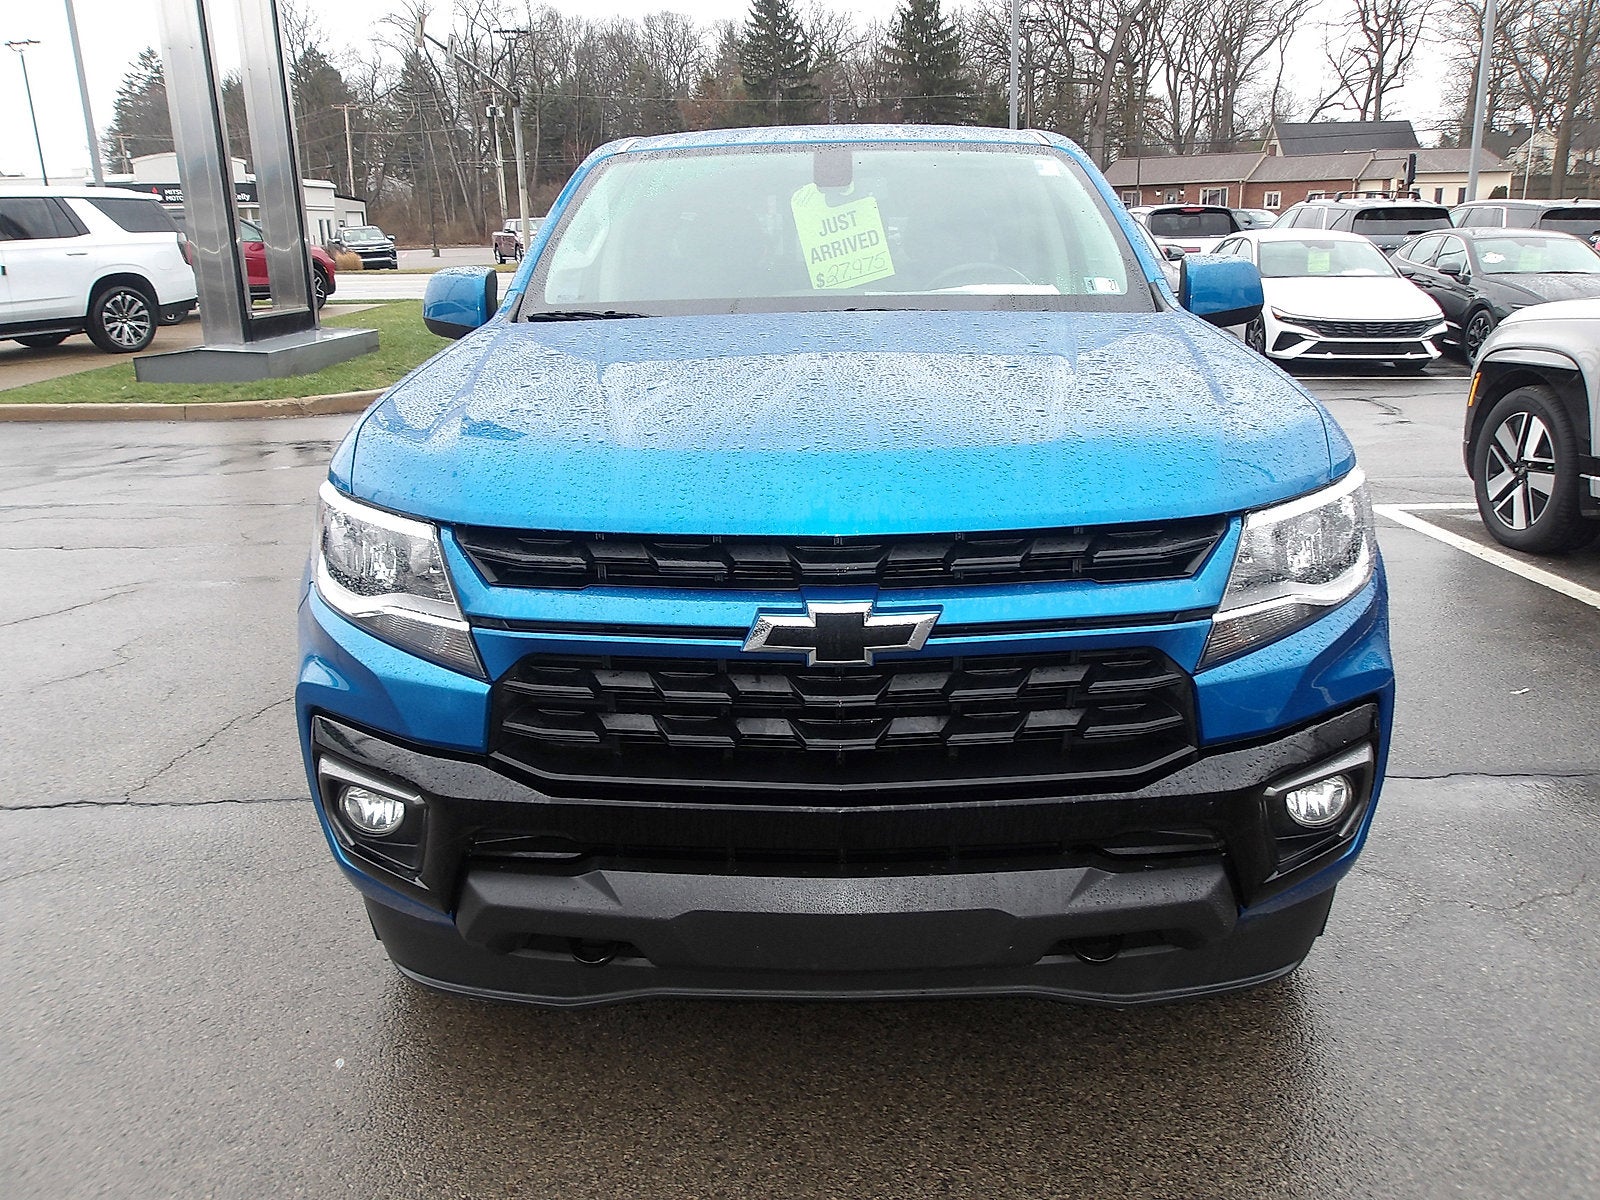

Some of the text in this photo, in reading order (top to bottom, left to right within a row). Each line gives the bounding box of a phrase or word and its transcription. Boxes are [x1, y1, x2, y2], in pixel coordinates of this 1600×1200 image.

[235, 193, 250, 201] elly
[818, 210, 857, 237] JUST
[810, 229, 880, 265] ARRIVED
